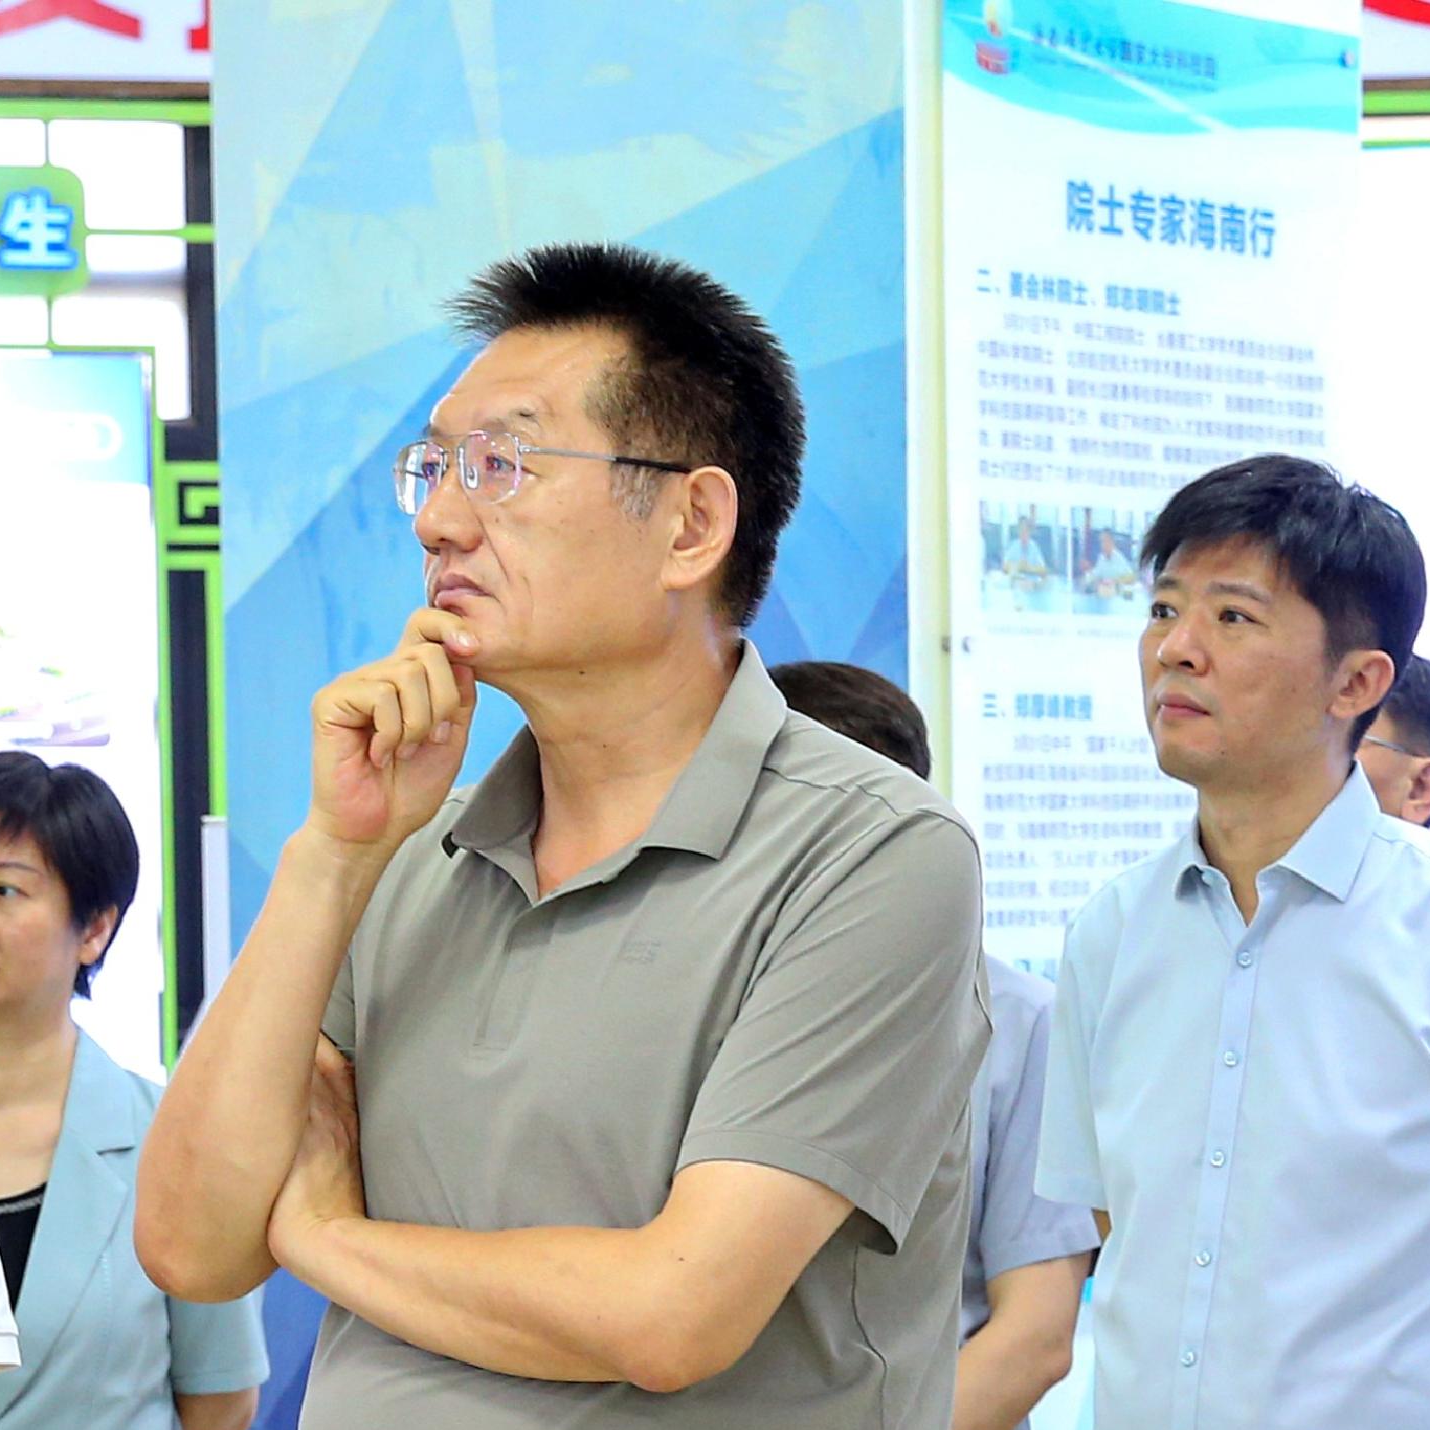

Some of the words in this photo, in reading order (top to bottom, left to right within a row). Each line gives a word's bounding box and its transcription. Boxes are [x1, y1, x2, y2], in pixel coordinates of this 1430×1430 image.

[1065, 179, 1278, 260] 院士专家海南行
